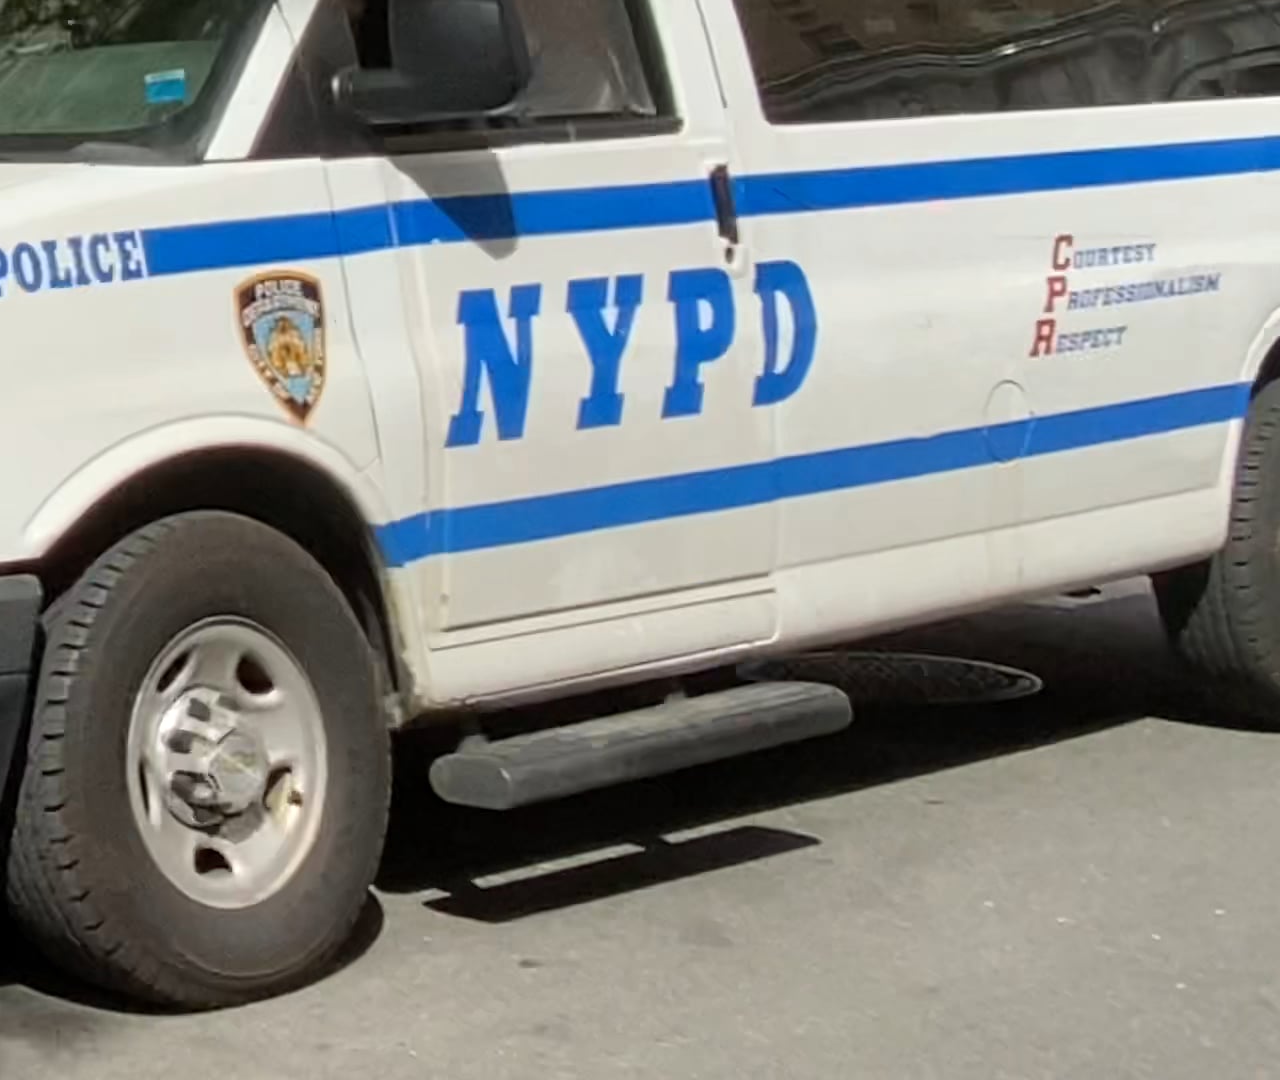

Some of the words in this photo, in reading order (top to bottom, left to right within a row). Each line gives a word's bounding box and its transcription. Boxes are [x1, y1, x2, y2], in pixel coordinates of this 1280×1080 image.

[1052, 234, 1157, 271] COURTESY
[1044, 274, 1222, 313] PROFESSIONALISM
[444, 259, 817, 448] NYPD
[1029, 319, 1128, 358] RESPECT
